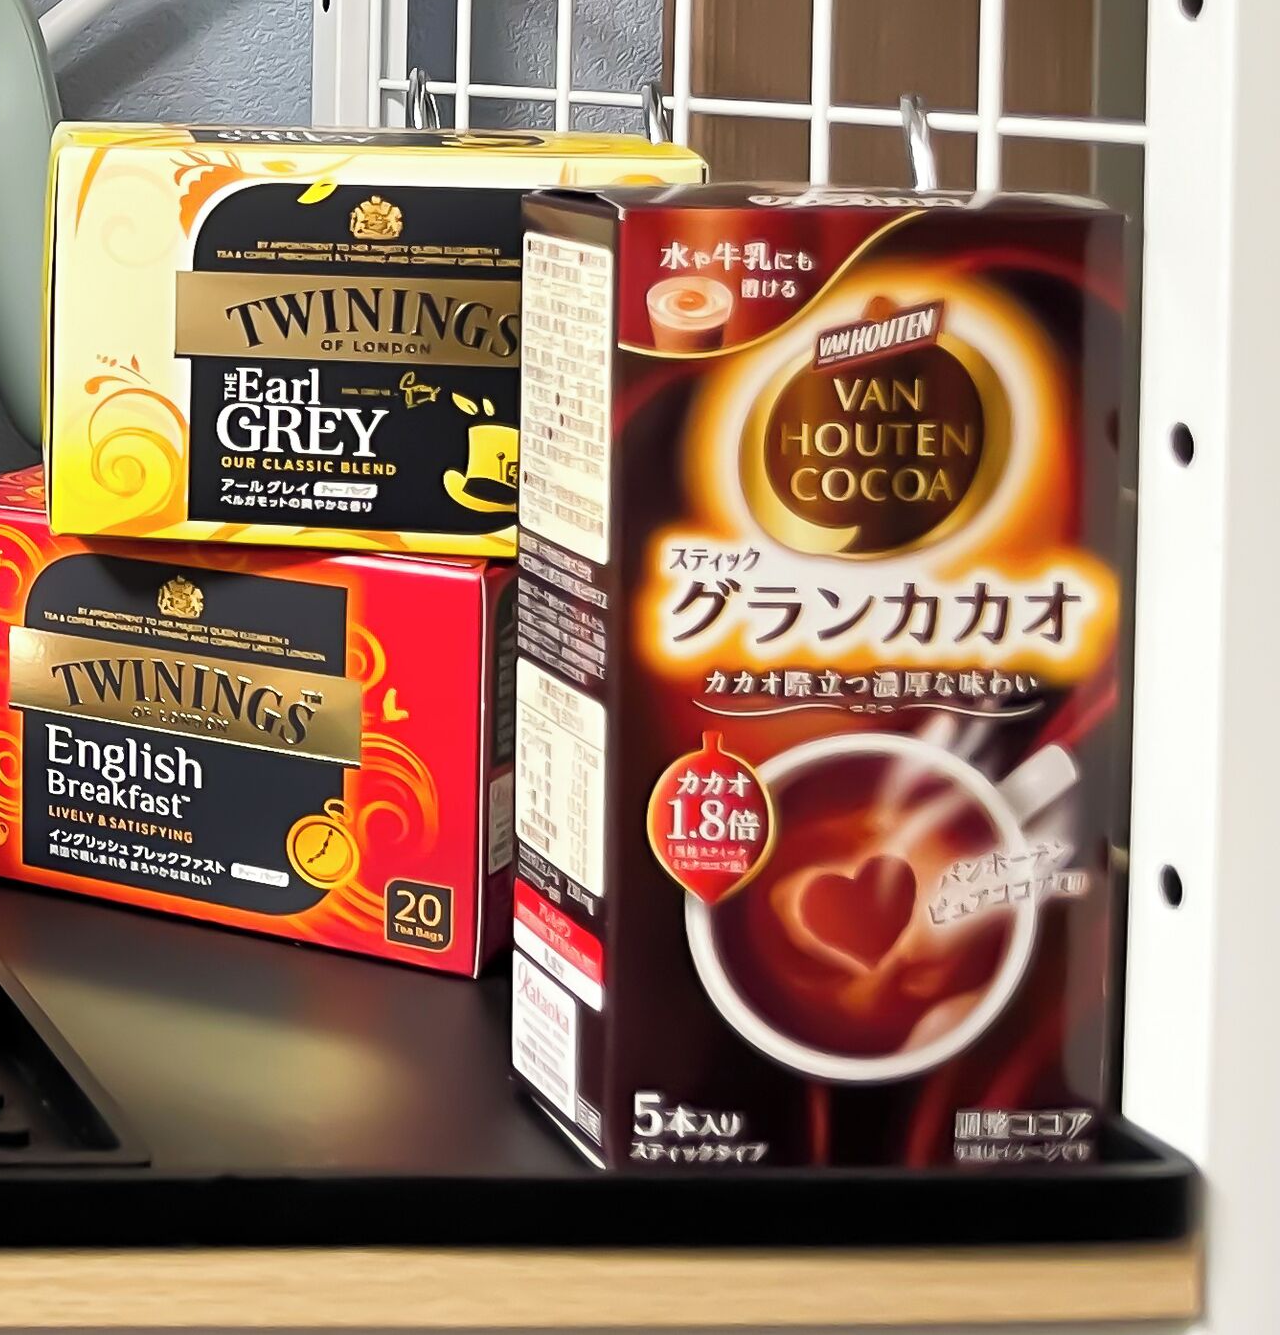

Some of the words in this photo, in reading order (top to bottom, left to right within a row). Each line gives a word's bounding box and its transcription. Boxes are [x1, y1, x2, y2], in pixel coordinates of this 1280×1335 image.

[659, 241, 814, 271] 水や牛乳にも
[225, 287, 522, 358] TWININGS
[819, 330, 851, 358] VAN
[848, 307, 936, 356] HOUTEN
[320, 339, 343, 353] OF
[353, 340, 432, 357] LONDON
[223, 372, 238, 400] THE
[236, 367, 322, 406] Earl
[832, 377, 923, 413] VAN
[216, 402, 390, 458] GREY
[779, 421, 972, 458] HOUTEN
[221, 456, 256, 470] OUR
[262, 458, 334, 473] CLASSIC
[340, 461, 398, 477] BLEND
[790, 466, 954, 503] COCOA
[669, 547, 761, 573] スティック
[671, 576, 1083, 646] グランカカオ
[51, 657, 317, 745] TWININGS
[45, 723, 203, 789] English
[676, 768, 751, 797] カカオ
[48, 804, 94, 825] LIVELY
[98, 814, 107, 827] &
[109, 816, 194, 844] SATISFYING
[666, 798, 761, 842] 1.8倍
[394, 890, 442, 927] 20
[393, 922, 414, 936] Tea
[415, 926, 444, 943] Bags
[633, 1091, 741, 1138] 5本入り
